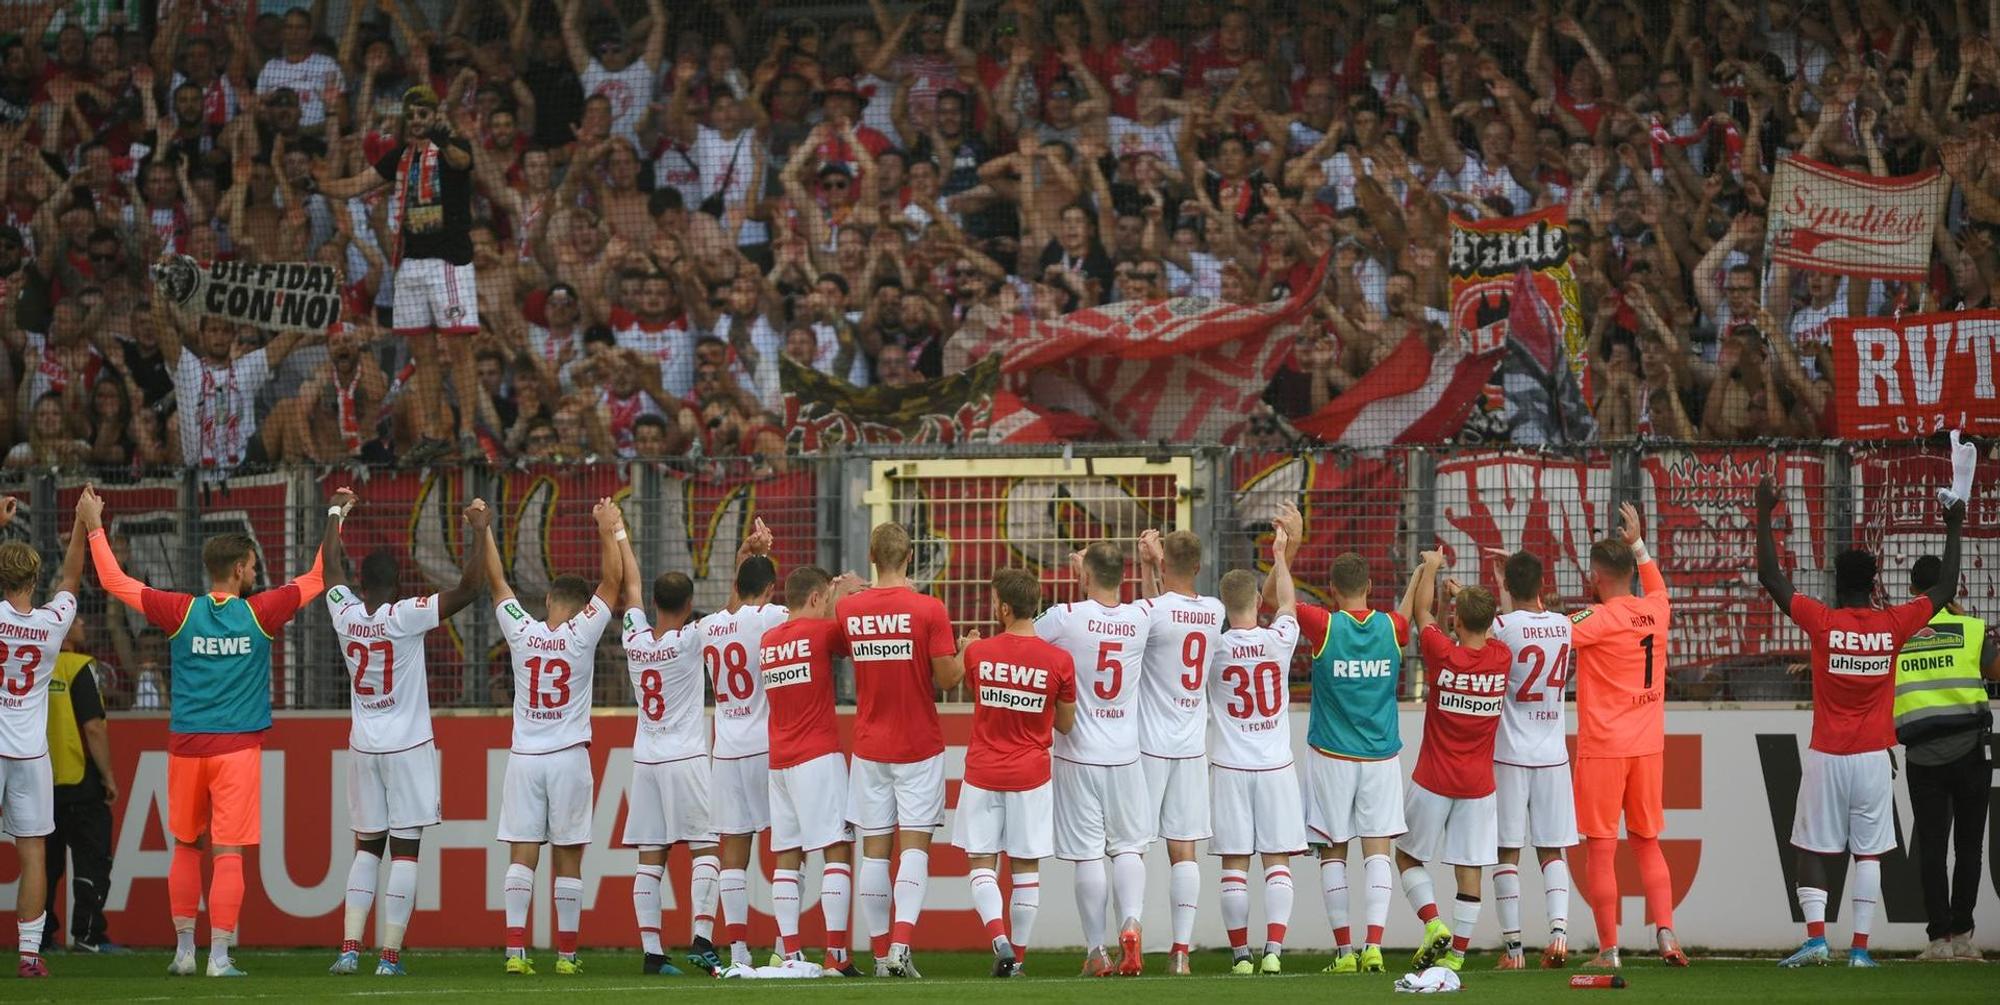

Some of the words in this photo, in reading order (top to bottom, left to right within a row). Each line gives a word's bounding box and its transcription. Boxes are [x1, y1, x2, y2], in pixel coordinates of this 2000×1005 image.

[1785, 184, 1926, 234] Syndikat
[847, 613, 911, 636] REWE
[1087, 619, 1136, 638] CZICHOS
[1171, 610, 1216, 626] TERODDE
[1630, 614, 1655, 628] HORN
[527, 635, 566, 651] SCHAUB
[1522, 625, 1567, 640] DREXLER
[1829, 630, 1894, 651] REWE
[192, 636, 251, 656] REWE
[853, 642, 911, 658] uhlsport
[1232, 643, 1266, 659] KAINZ
[346, 639, 394, 696] 27
[1093, 641, 1123, 701] 5
[1181, 631, 1207, 691] 9
[1333, 659, 1392, 678] REWE
[1639, 633, 1655, 689] 1
[1831, 657, 1890, 673] uhlsport
[1901, 655, 1954, 672] ORDNER
[525, 656, 571, 709] 13
[703, 641, 755, 703] 28
[763, 665, 808, 686] hlsport
[979, 661, 1048, 689] REWE
[1437, 668, 1506, 693] REWE
[1516, 643, 1569, 702] 24
[640, 668, 666, 722] 8
[982, 688, 1044, 709] uhlsport
[1222, 661, 1282, 719] 30
[1095, 708, 1106, 718] FC
[1441, 695, 1501, 713] uhlsport
[1249, 722, 1260, 732] FC
